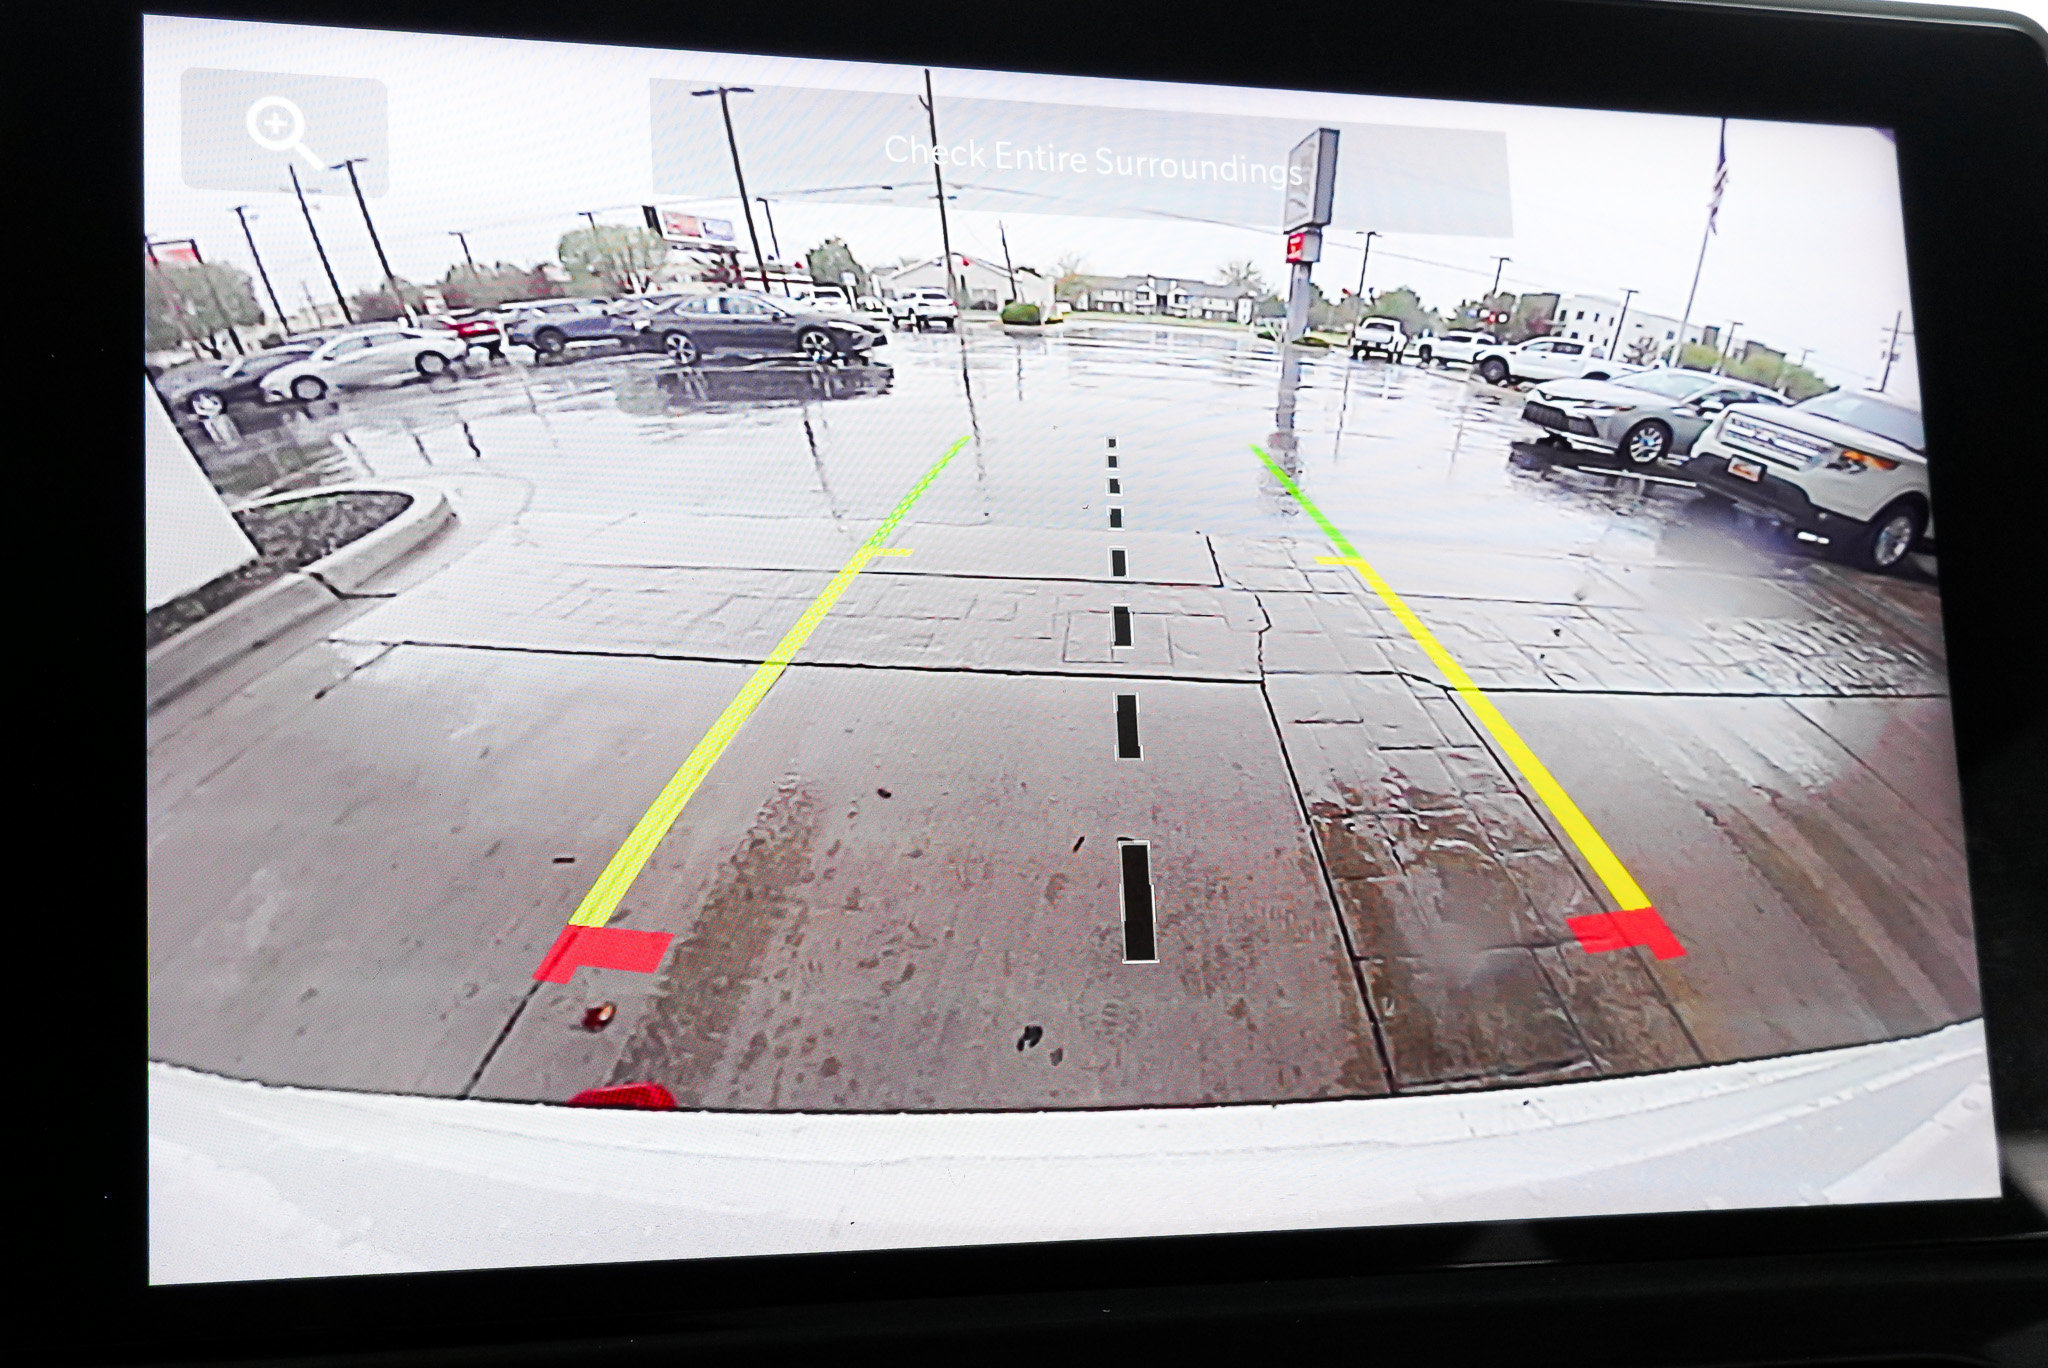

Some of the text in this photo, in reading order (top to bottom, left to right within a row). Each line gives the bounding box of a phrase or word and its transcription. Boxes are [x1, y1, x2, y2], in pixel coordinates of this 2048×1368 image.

[885, 135, 1304, 190] Check Entire Surroundings
